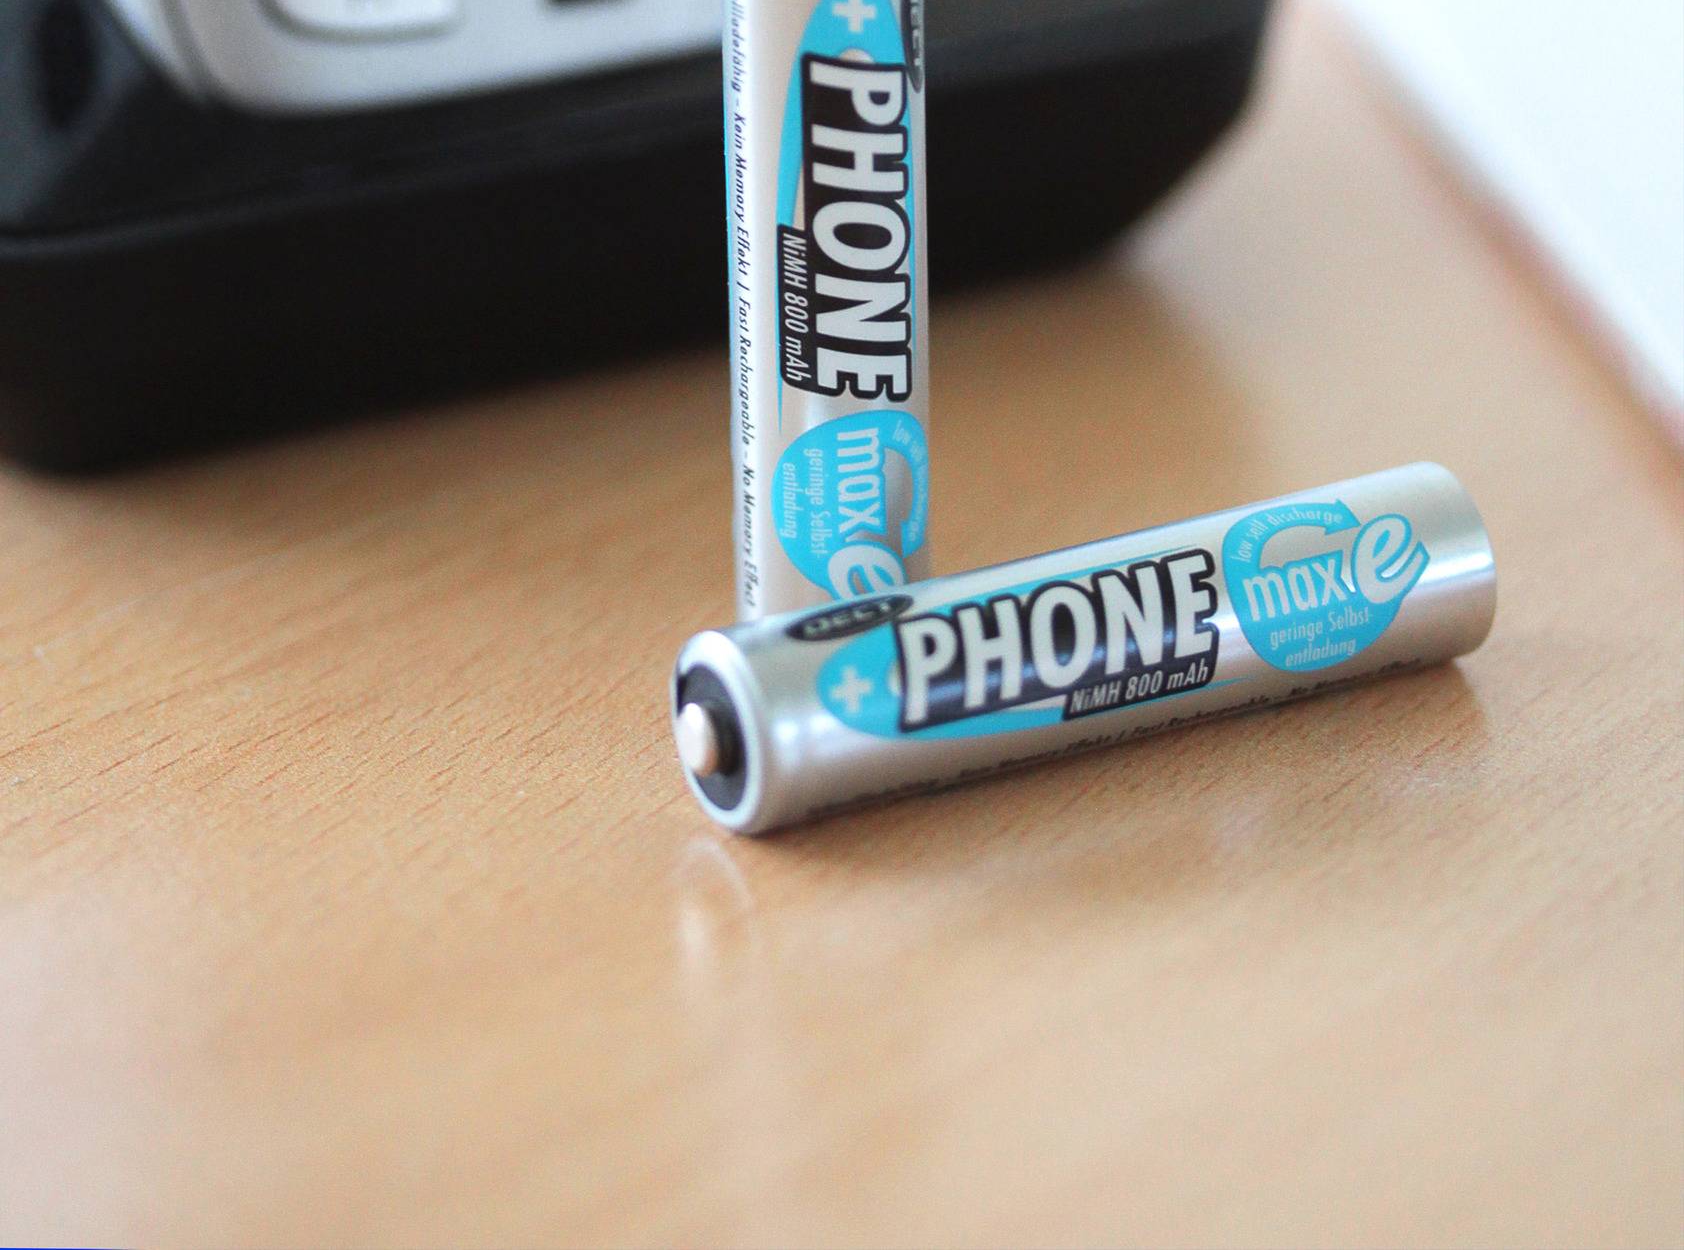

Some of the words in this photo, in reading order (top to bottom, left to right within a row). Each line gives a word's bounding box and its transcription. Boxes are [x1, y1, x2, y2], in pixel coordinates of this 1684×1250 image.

[734, 153, 748, 223] Memory
[736, 226, 751, 279] Effekt
[808, 59, 910, 396] PHONE
[783, 232, 808, 289] NiMH
[737, 297, 752, 333] Fast
[784, 291, 809, 334] 800
[786, 335, 812, 382] mAh
[739, 334, 755, 446] Rechargeable
[742, 464, 756, 487] No
[780, 461, 805, 540] entladung
[803, 447, 825, 507] geringe
[743, 490, 757, 557] Memory
[1267, 506, 1344, 529] discharge
[900, 552, 1214, 725] PHONE
[1269, 619, 1324, 651] geringe
[1284, 636, 1357, 668] entladung
[1069, 678, 1123, 714] NiMH
[1124, 669, 1164, 700] 800
[1166, 656, 1209, 690] mAh
